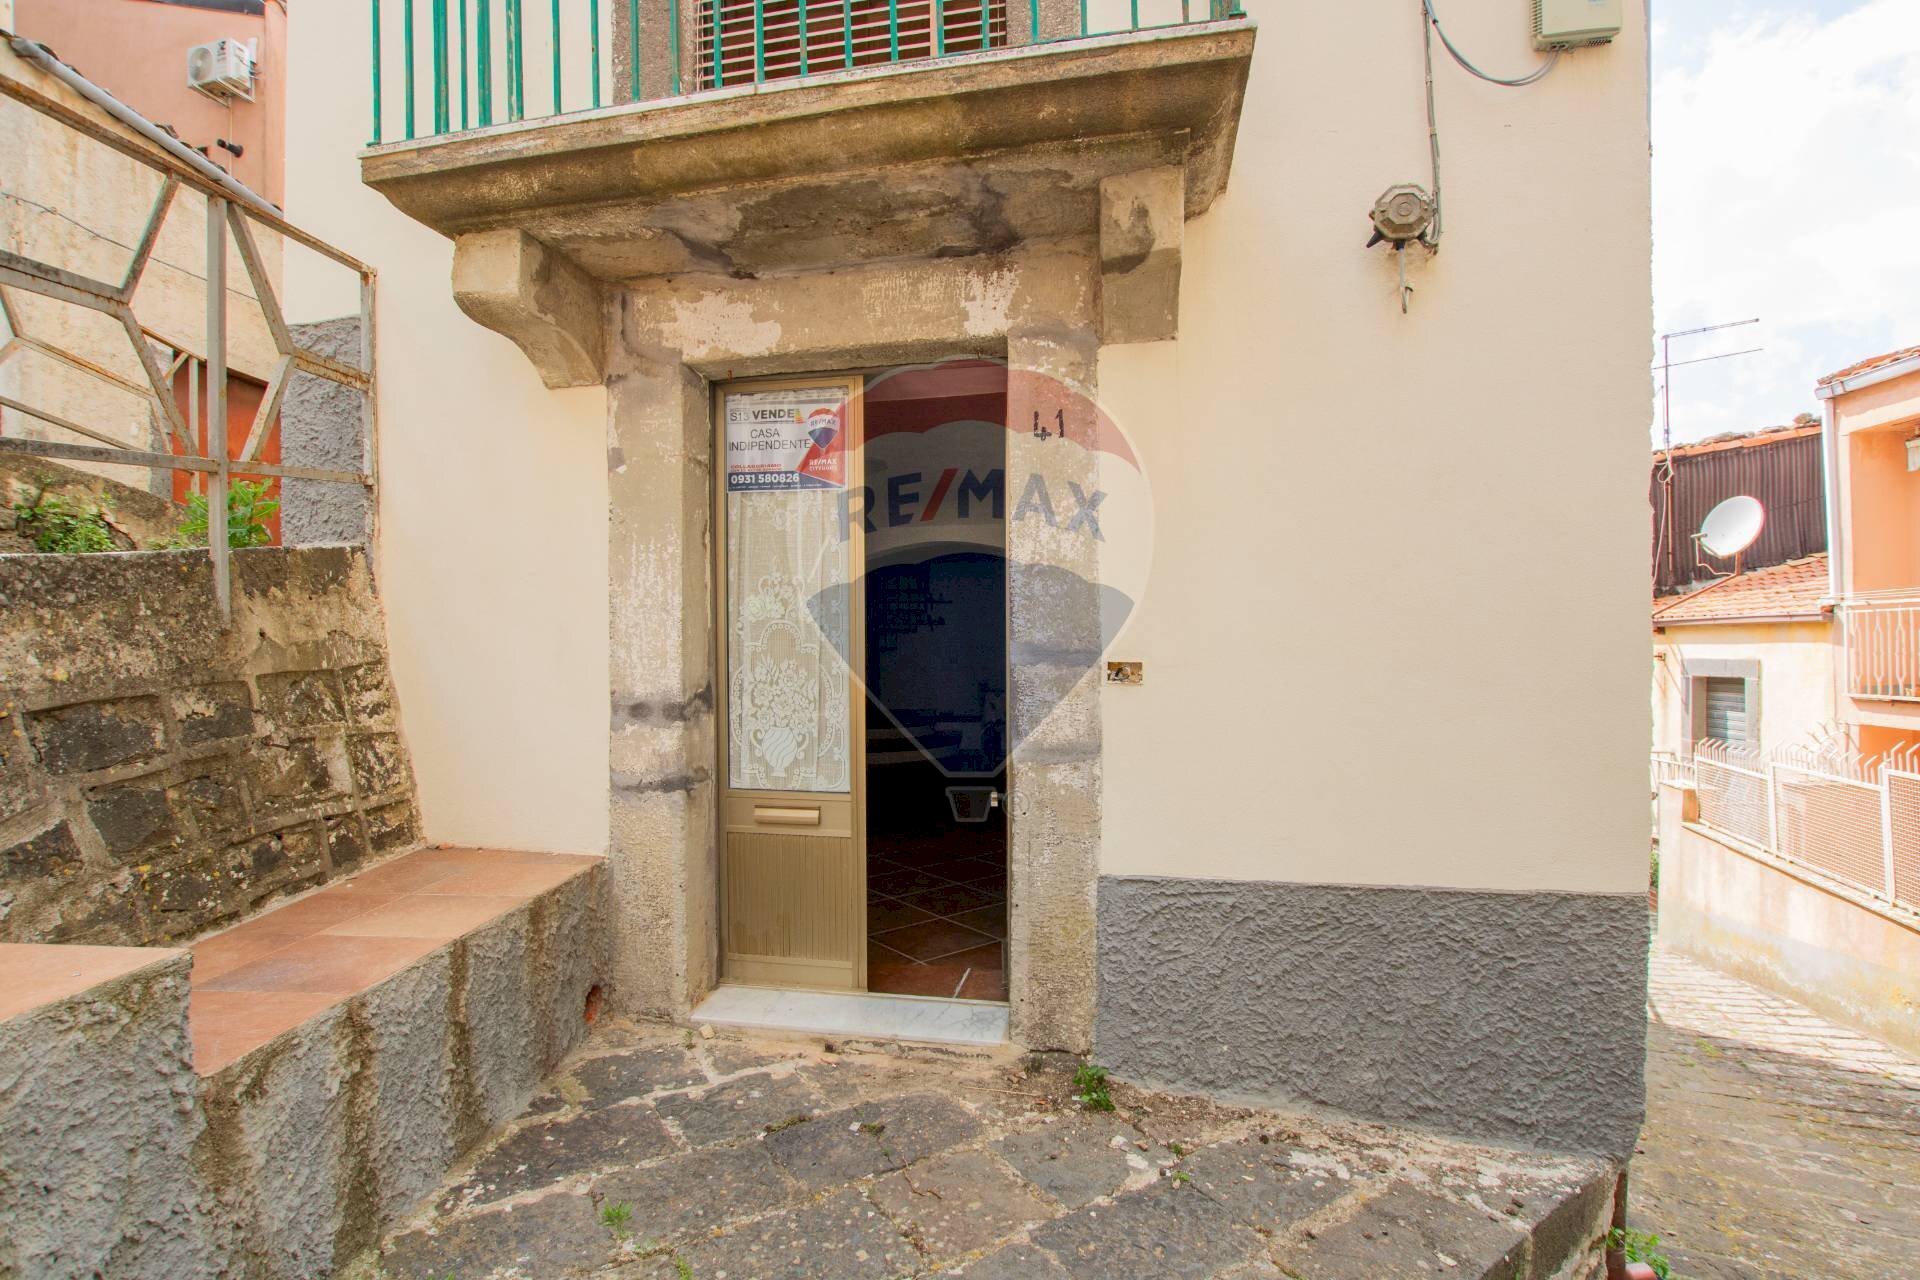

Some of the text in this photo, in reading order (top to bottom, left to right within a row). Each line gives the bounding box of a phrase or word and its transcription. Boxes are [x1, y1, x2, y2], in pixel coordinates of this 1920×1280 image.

[752, 409, 795, 420] VENDE
[810, 417, 836, 427] RE/MAX
[1033, 408, 1064, 441] 41
[750, 428, 780, 439] CASA
[729, 439, 812, 451] INDIPENDENTE
[809, 458, 838, 466] RE/MAX
[730, 473, 800, 484] 0931 580826
